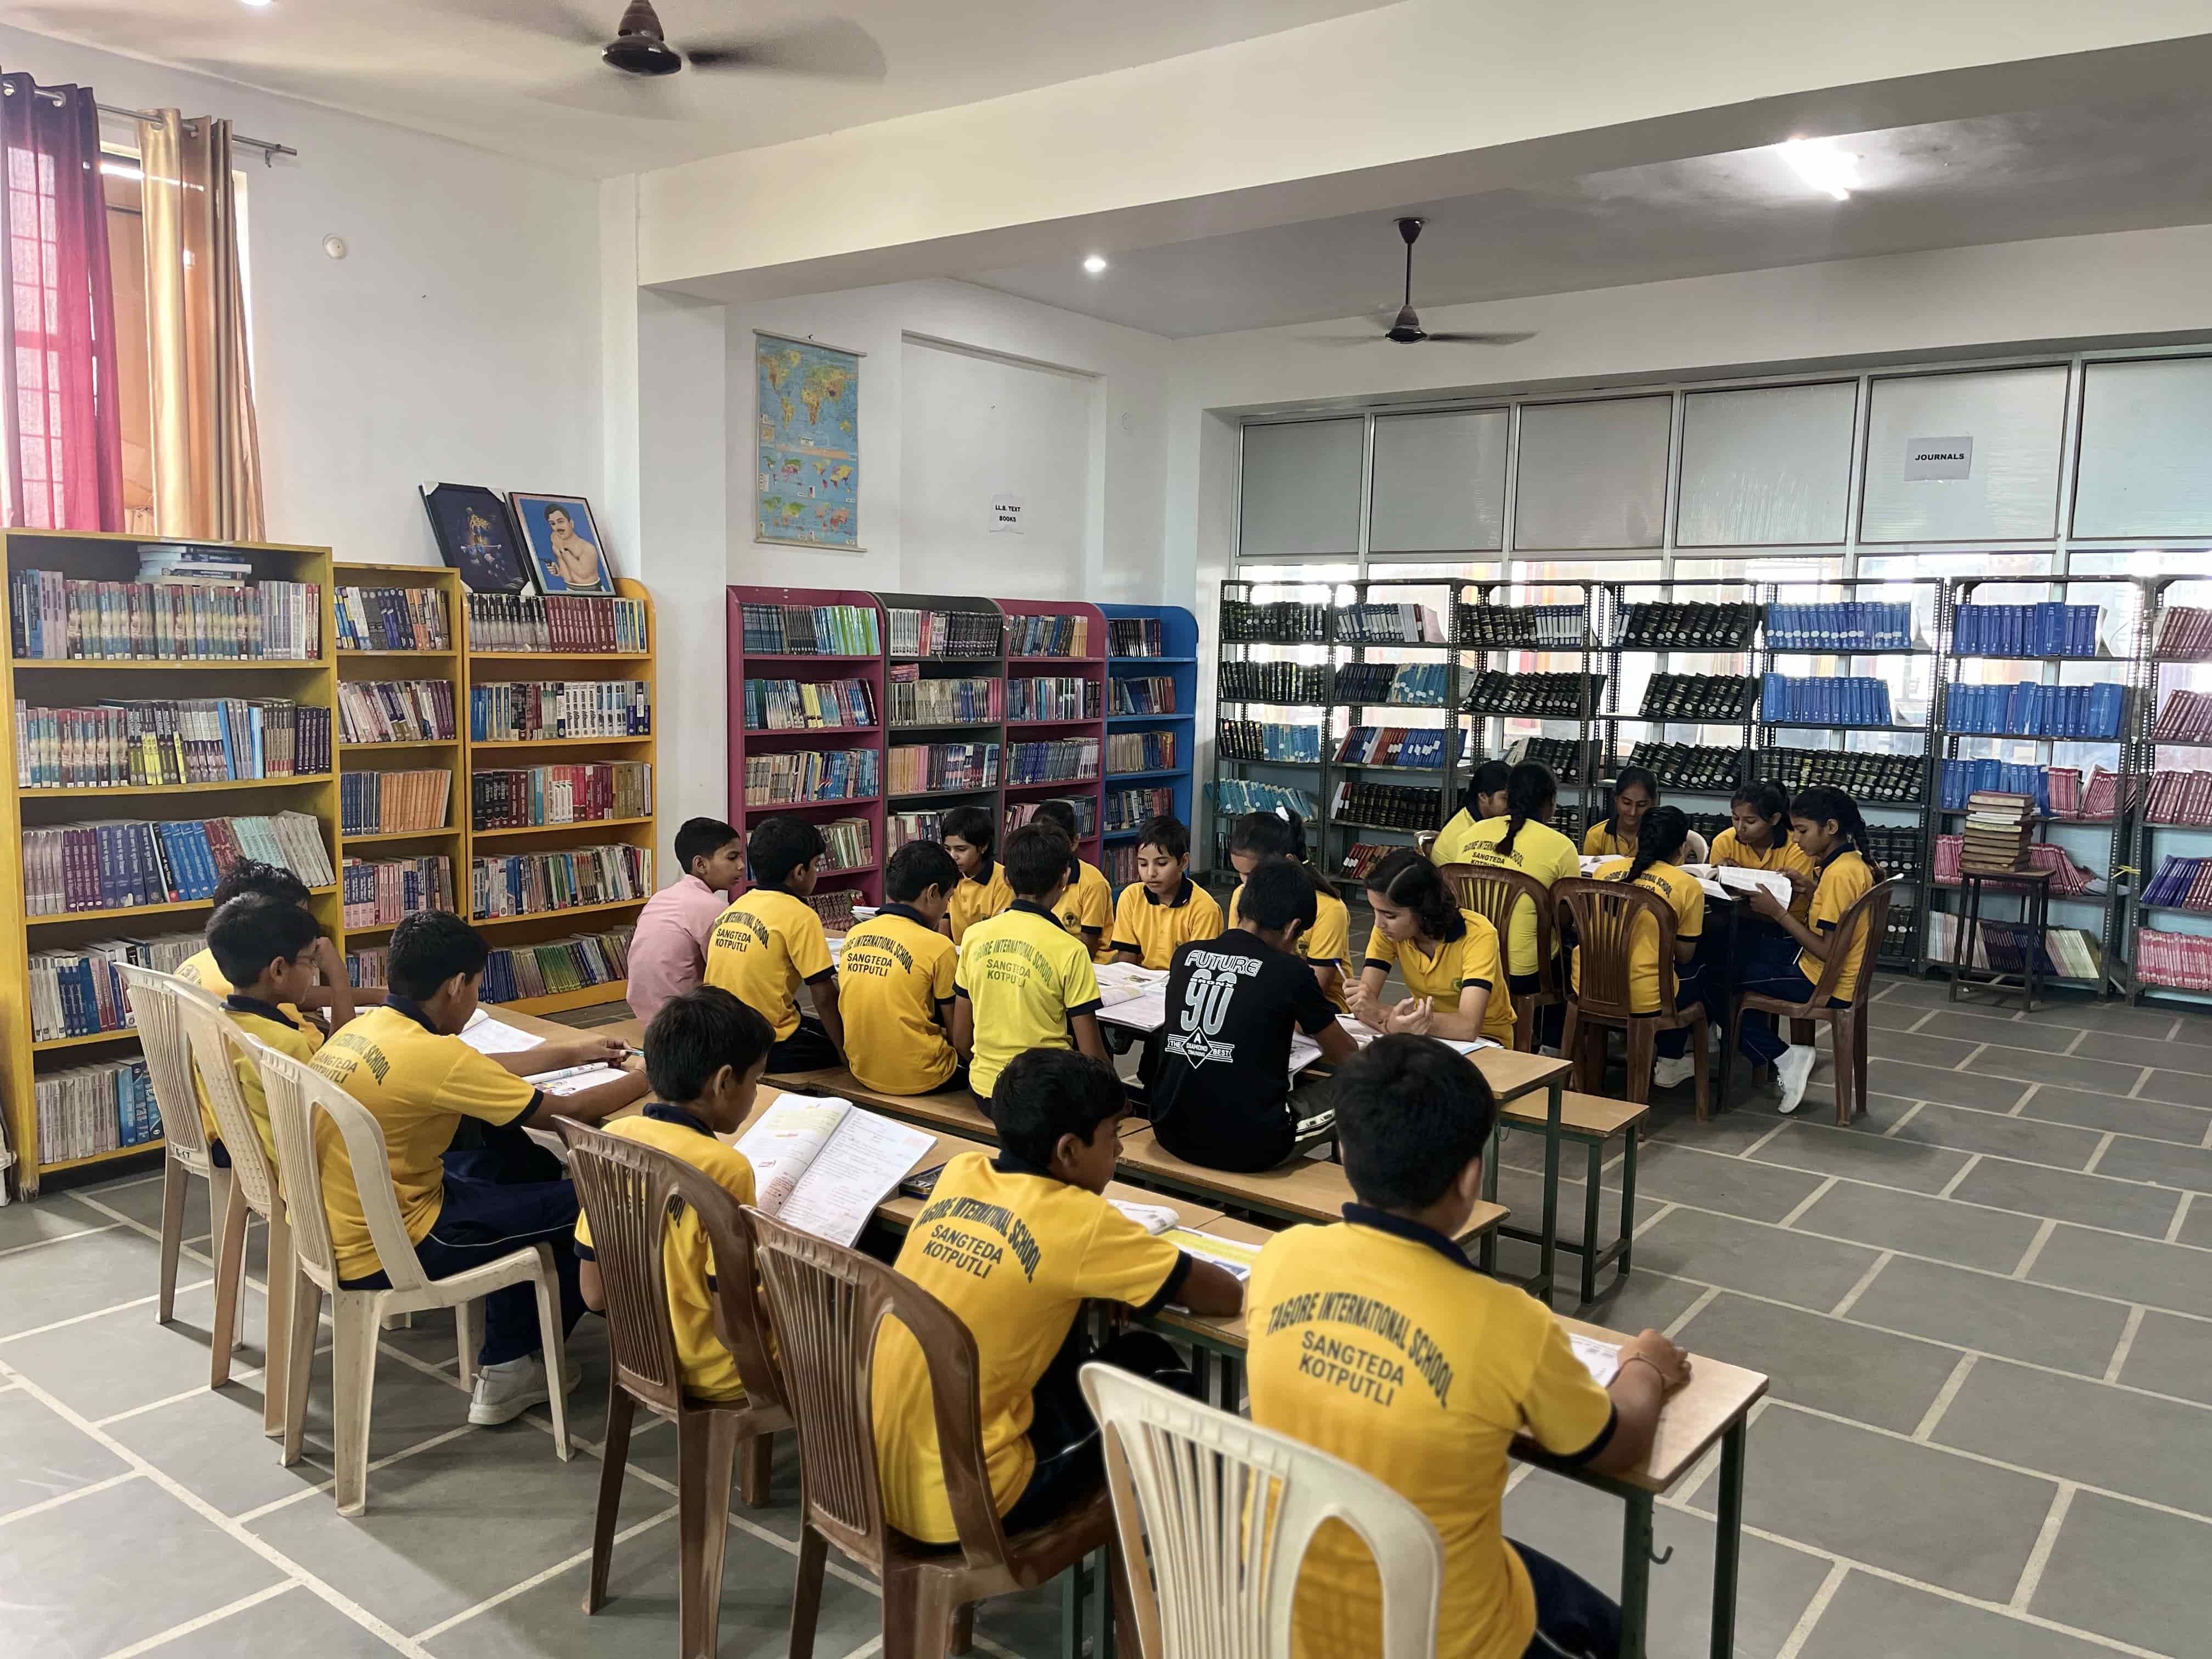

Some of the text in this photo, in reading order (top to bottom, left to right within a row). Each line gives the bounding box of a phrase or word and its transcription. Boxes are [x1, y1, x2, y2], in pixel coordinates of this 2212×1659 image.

[1915, 453, 1965, 461] JOURNALS
[1471, 851, 1505, 865] SANGTEDA
[715, 938, 747, 953] KOTPUTLI
[716, 928, 751, 943] SANGTEDA
[847, 952, 893, 968] SANGTEDA
[853, 934, 896, 953] INTERNATIONAL
[893, 944, 913, 975] SCHOOL
[992, 939, 1035, 961] INTERNATIONAL
[1032, 951, 1053, 987] SCHOOL
[1184, 949, 1263, 977] FUTURE
[847, 963, 889, 978] KOTPUTLI
[986, 958, 1031, 979] SANGTEDA
[1189, 977, 1234, 988] BRONX
[1180, 968, 1237, 1035] 90
[1170, 1040, 1181, 1048] THE
[1186, 1042, 1208, 1052] DIAMOND
[1193, 1032, 1201, 1044] A
[314, 1053, 359, 1073] SANGTEDA
[363, 1045, 391, 1086] SCHOOL
[931, 1224, 1003, 1265] SANGTEDA
[1007, 1218, 1041, 1284] SCHOOL
[922, 1239, 992, 1279] KOTPUTLI
[1266, 1291, 1454, 1409] TAGORE INTERNATIONAL SCHOOL
[1301, 1329, 1405, 1387] SANGTEDA
[1298, 1352, 1396, 1408] KOTPUTLI
